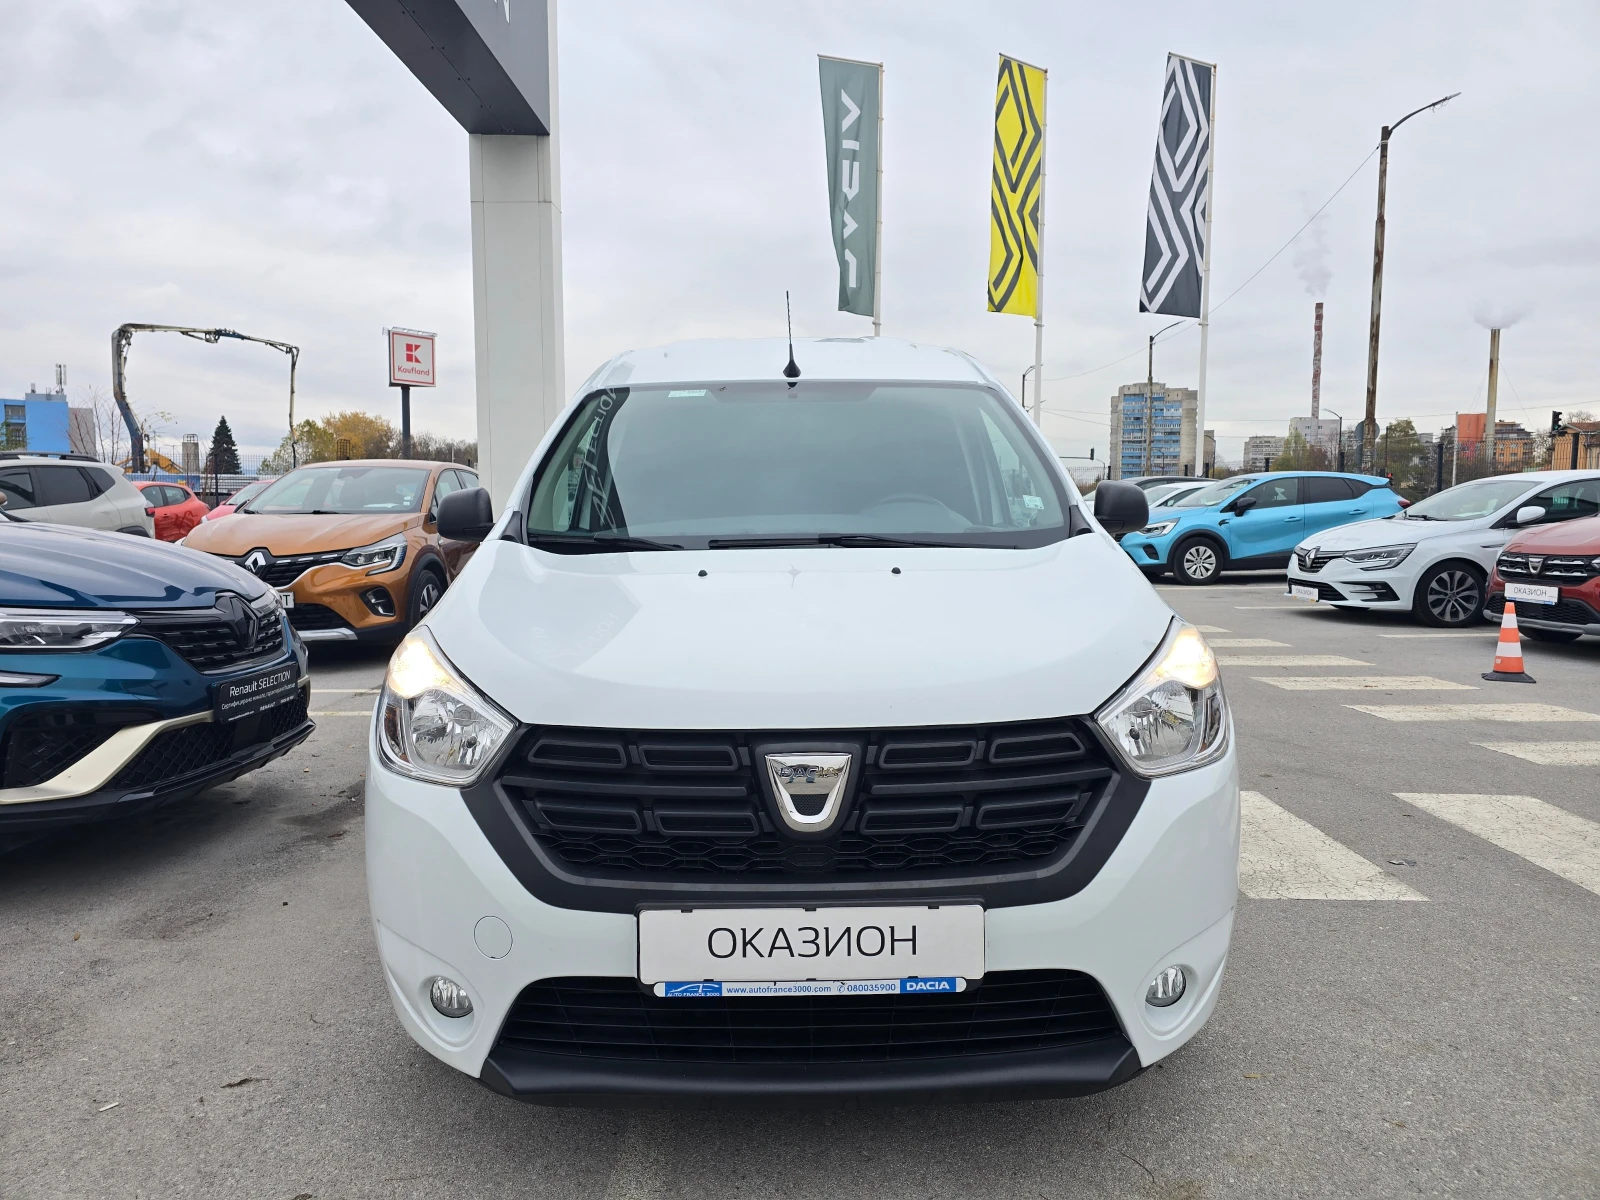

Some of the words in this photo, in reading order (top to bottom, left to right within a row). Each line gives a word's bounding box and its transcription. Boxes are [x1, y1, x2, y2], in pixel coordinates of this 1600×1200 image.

[397, 365, 430, 376] Kaufland
[1295, 588, 1314, 596] ОКАЗИОН
[1513, 586, 1547, 597] ОКАЗИОН
[229, 680, 258, 697] Renault
[258, 670, 291, 690] SELECTION
[779, 766, 839, 778] DACIA
[707, 925, 918, 959] ОКАЗИОН
[726, 984, 832, 995] www.autofrance3000.com
[847, 983, 896, 993] 080035900
[906, 981, 950, 991] DACIA
